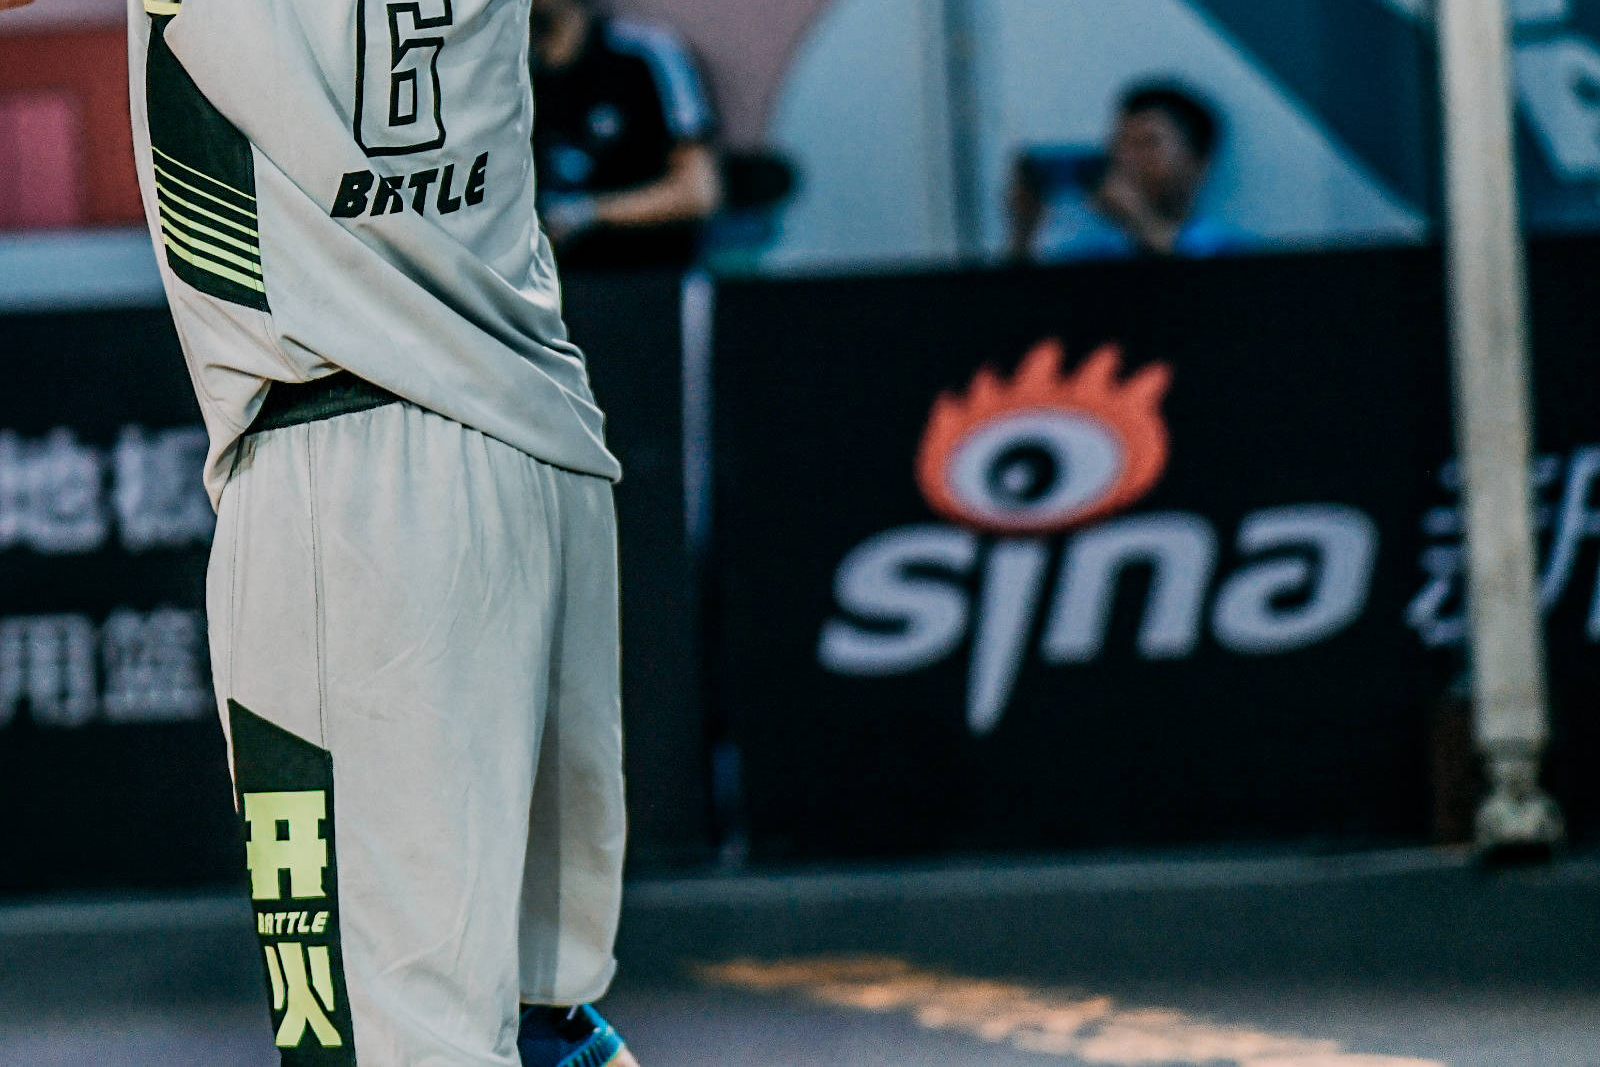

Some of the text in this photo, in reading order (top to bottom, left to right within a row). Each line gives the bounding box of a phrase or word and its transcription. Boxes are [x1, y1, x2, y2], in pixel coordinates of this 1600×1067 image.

[817, 502, 1380, 734] sina
[243, 790, 328, 900] 开
[257, 911, 329, 934] BATTLE
